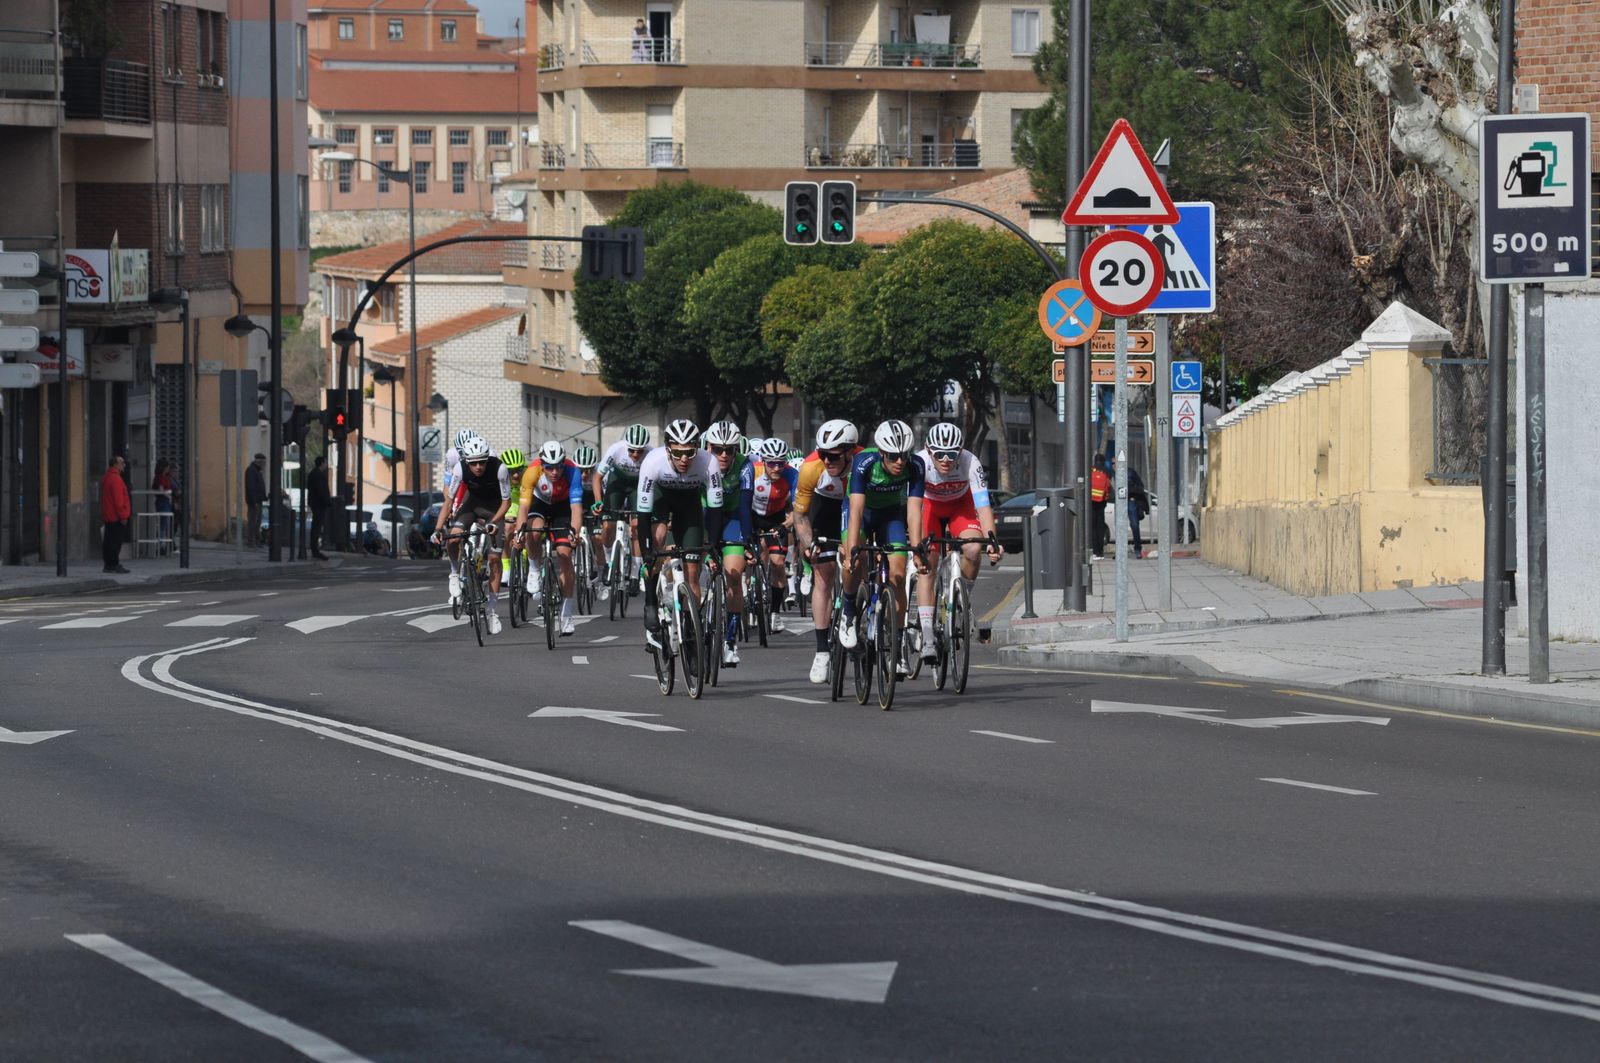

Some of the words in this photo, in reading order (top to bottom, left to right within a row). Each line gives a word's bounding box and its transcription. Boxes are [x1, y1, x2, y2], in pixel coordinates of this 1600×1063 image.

[1493, 232, 1547, 254] 500
[1558, 236, 1579, 252] m
[1098, 258, 1146, 287] 20
[1181, 420, 1192, 428] 30
